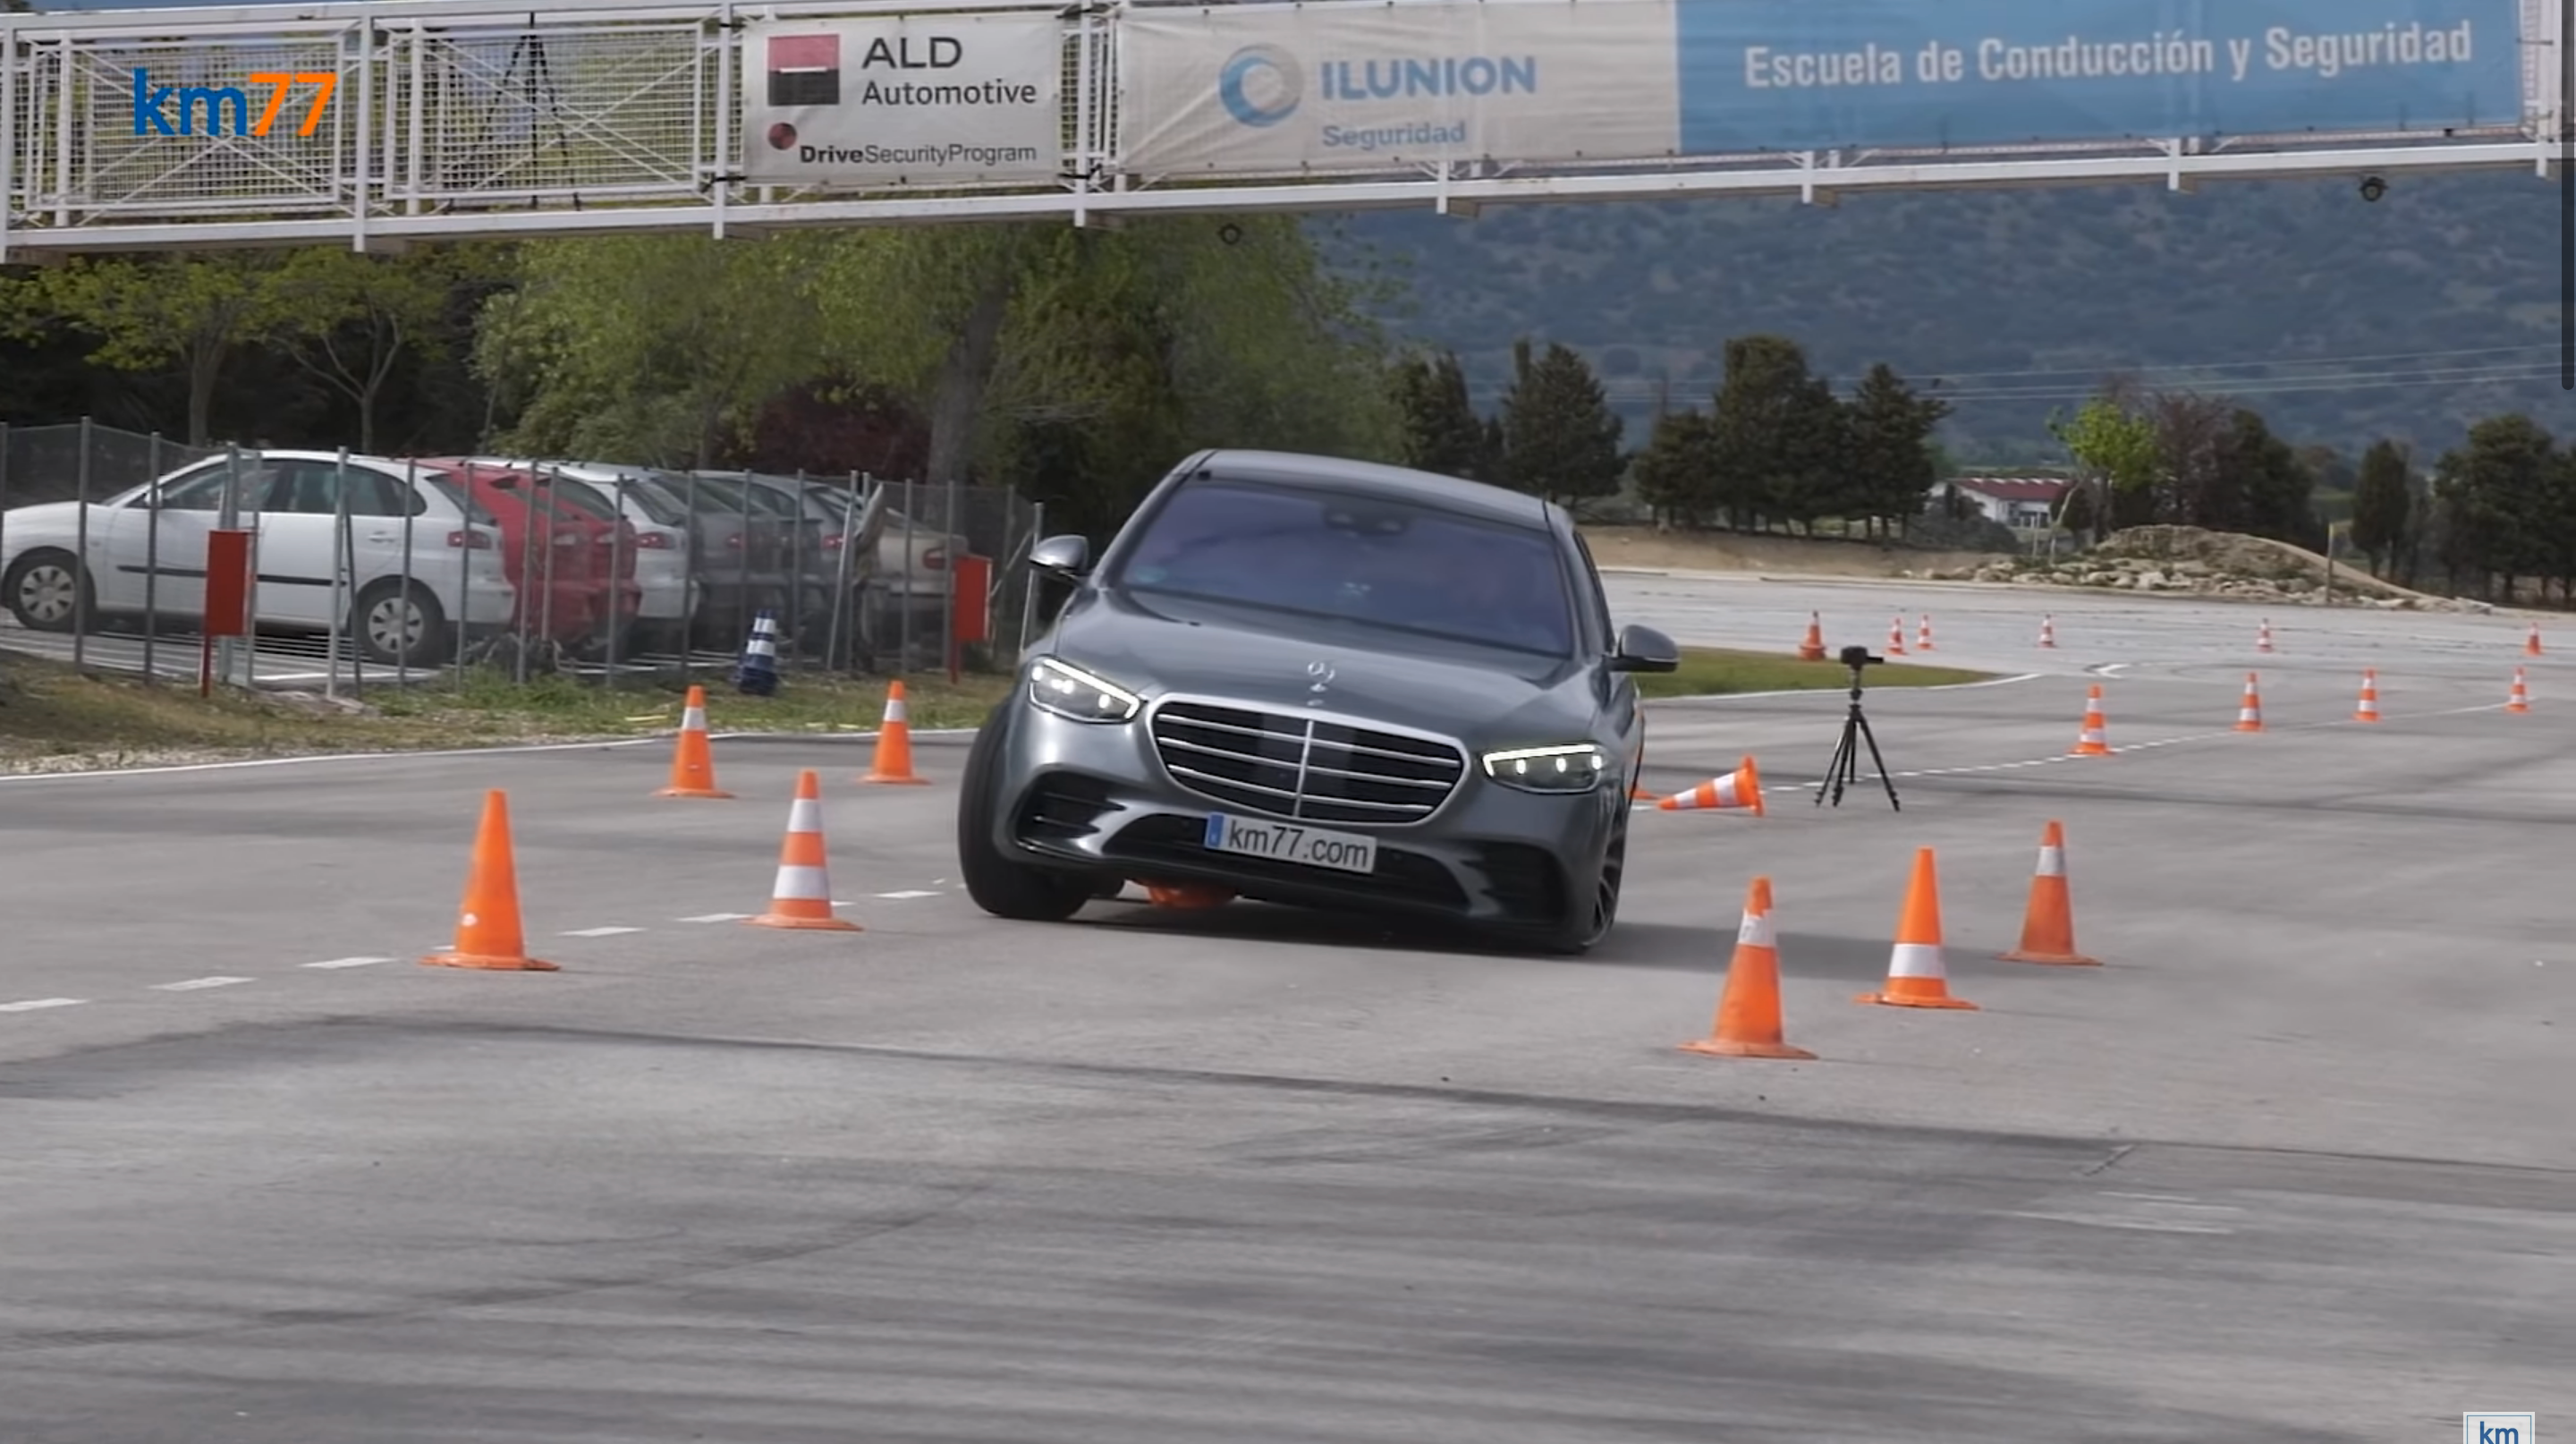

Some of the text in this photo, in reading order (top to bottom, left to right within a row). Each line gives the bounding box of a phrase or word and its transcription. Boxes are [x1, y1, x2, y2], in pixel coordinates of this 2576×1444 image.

[861, 37, 963, 70] ALD
[1744, 20, 2472, 89] Escuela de Conducción y Seguridad
[861, 79, 1038, 106] Automotive
[1320, 55, 1538, 100] ILUNION
[1322, 121, 1467, 150] Seguridad
[1228, 820, 1368, 869] km77.com
